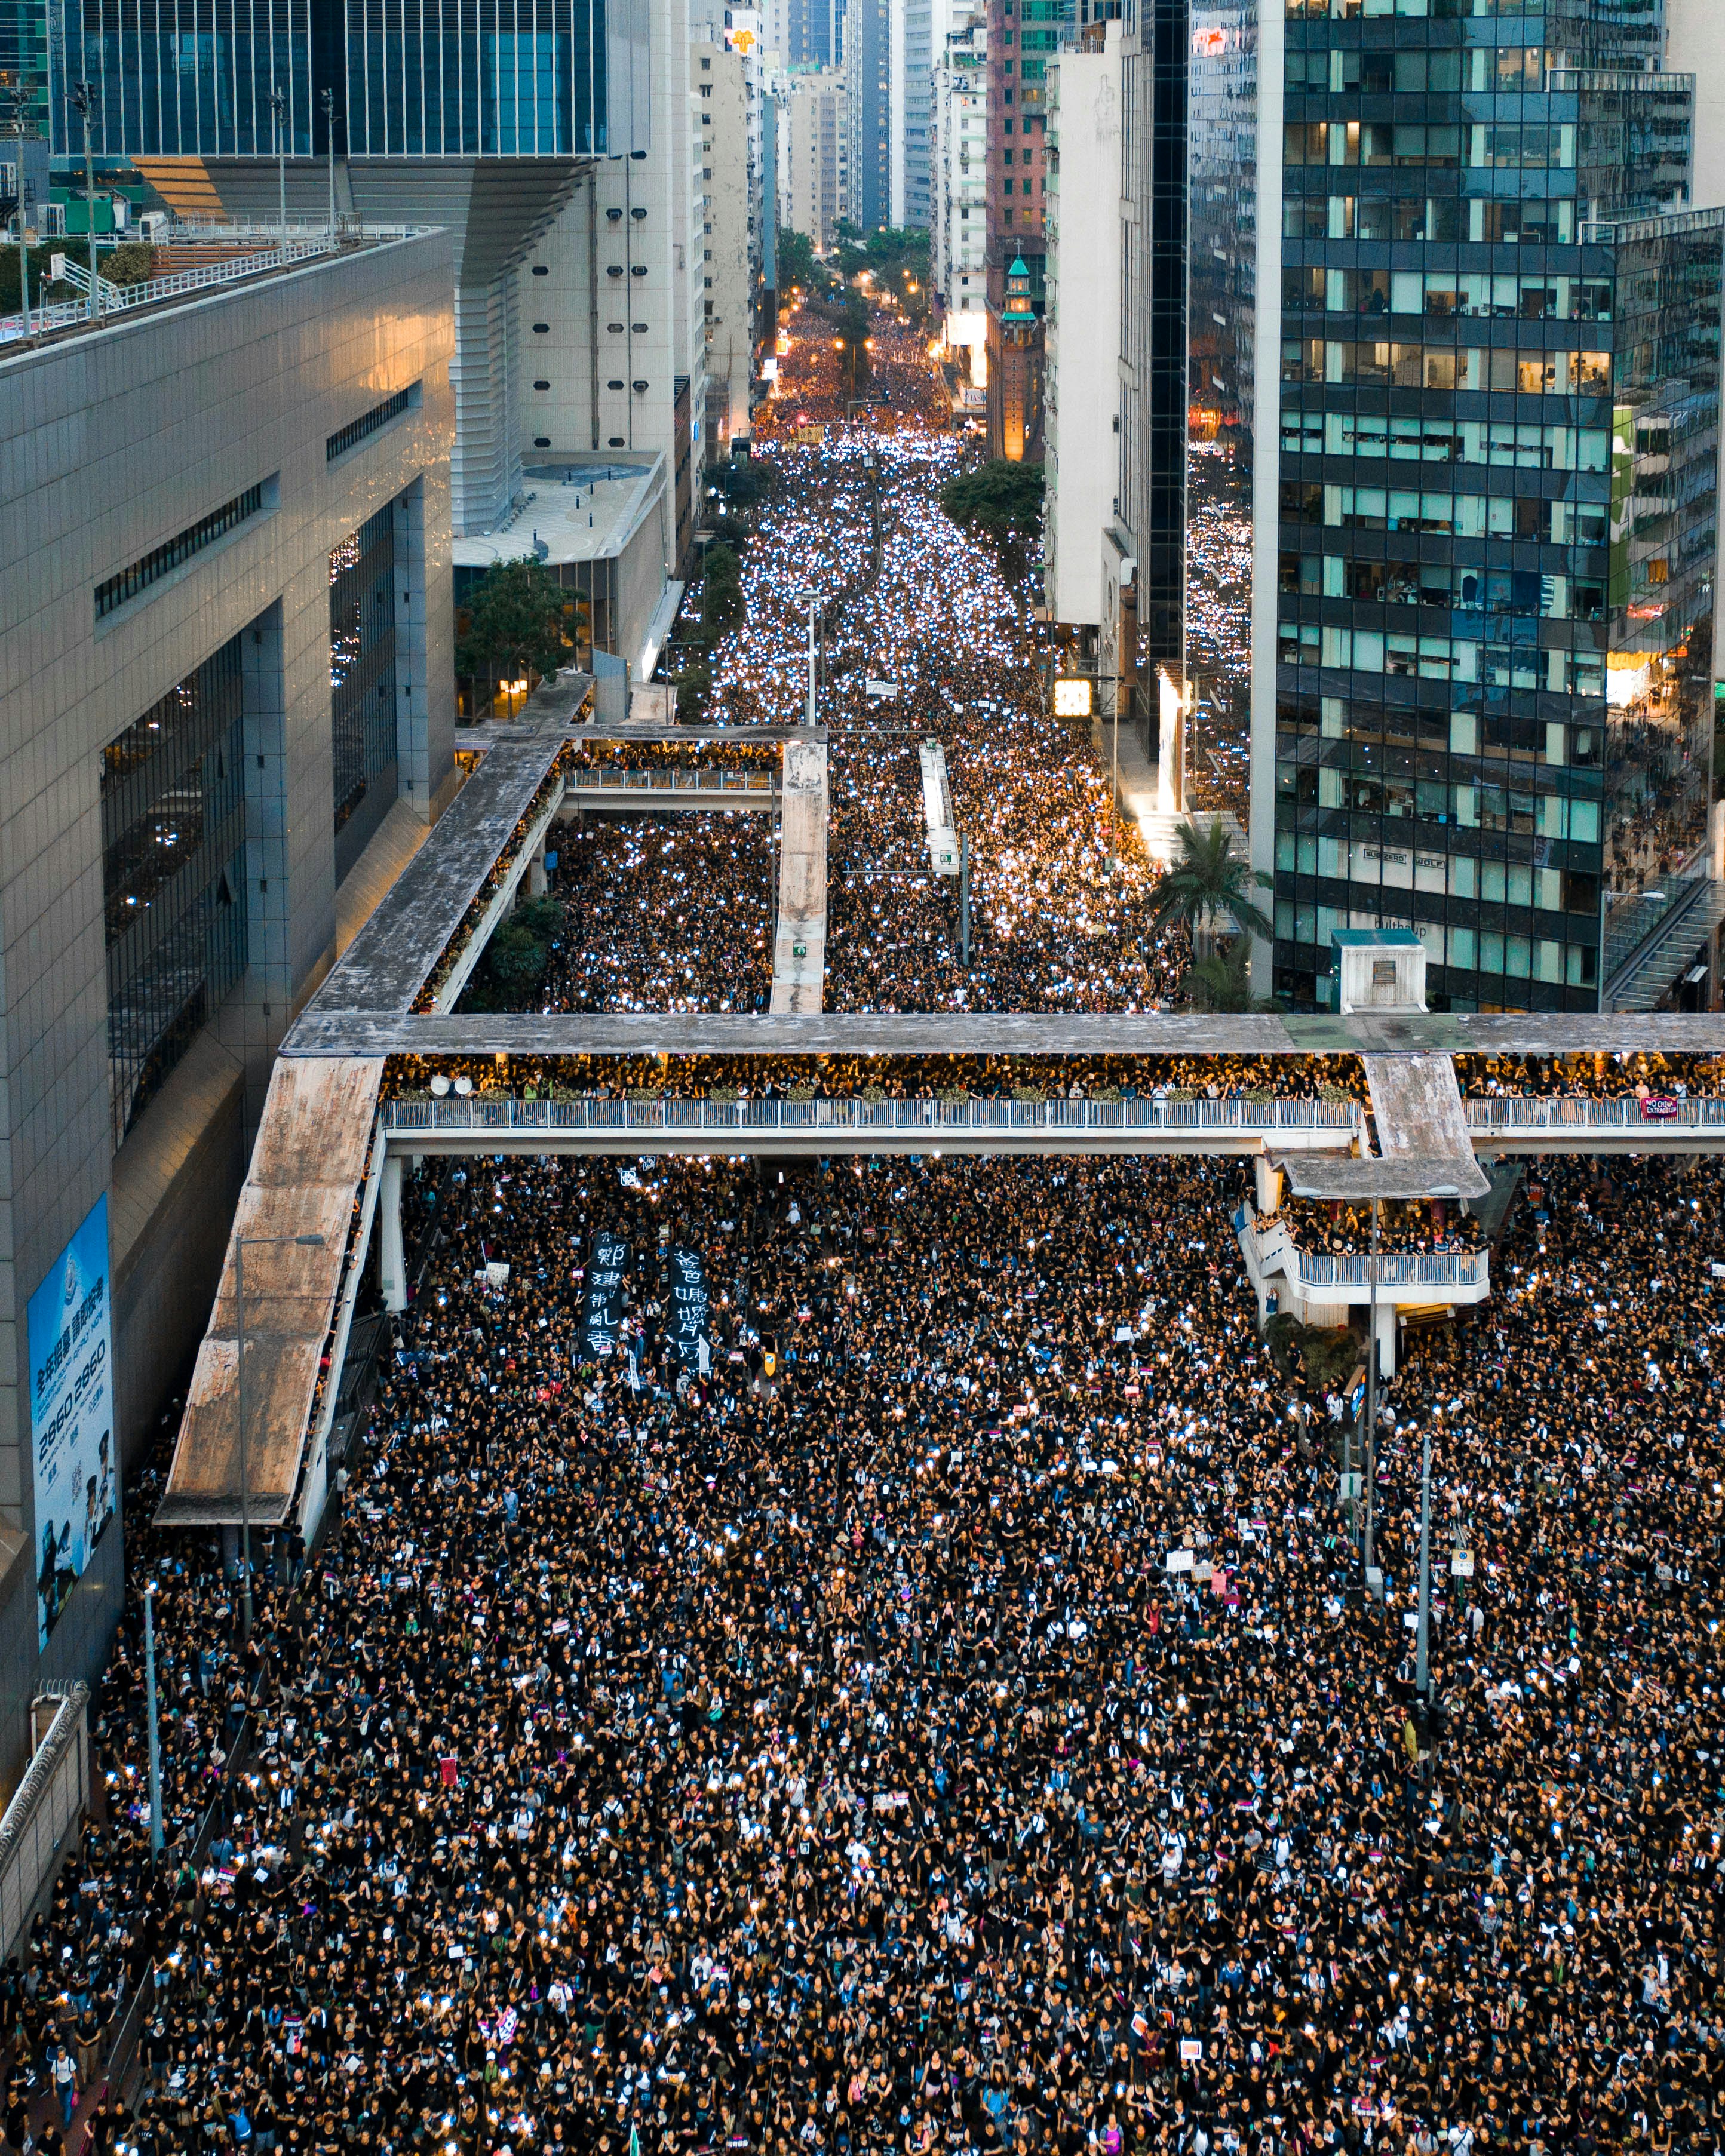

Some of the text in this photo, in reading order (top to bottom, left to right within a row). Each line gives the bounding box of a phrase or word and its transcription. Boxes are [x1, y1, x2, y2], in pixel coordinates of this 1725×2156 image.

[36, 1323, 70, 1401] 全年招募
[71, 1274, 103, 1344] 請即投考
[39, 1390, 72, 1463] 2860
[74, 1337, 105, 1403] 2860
